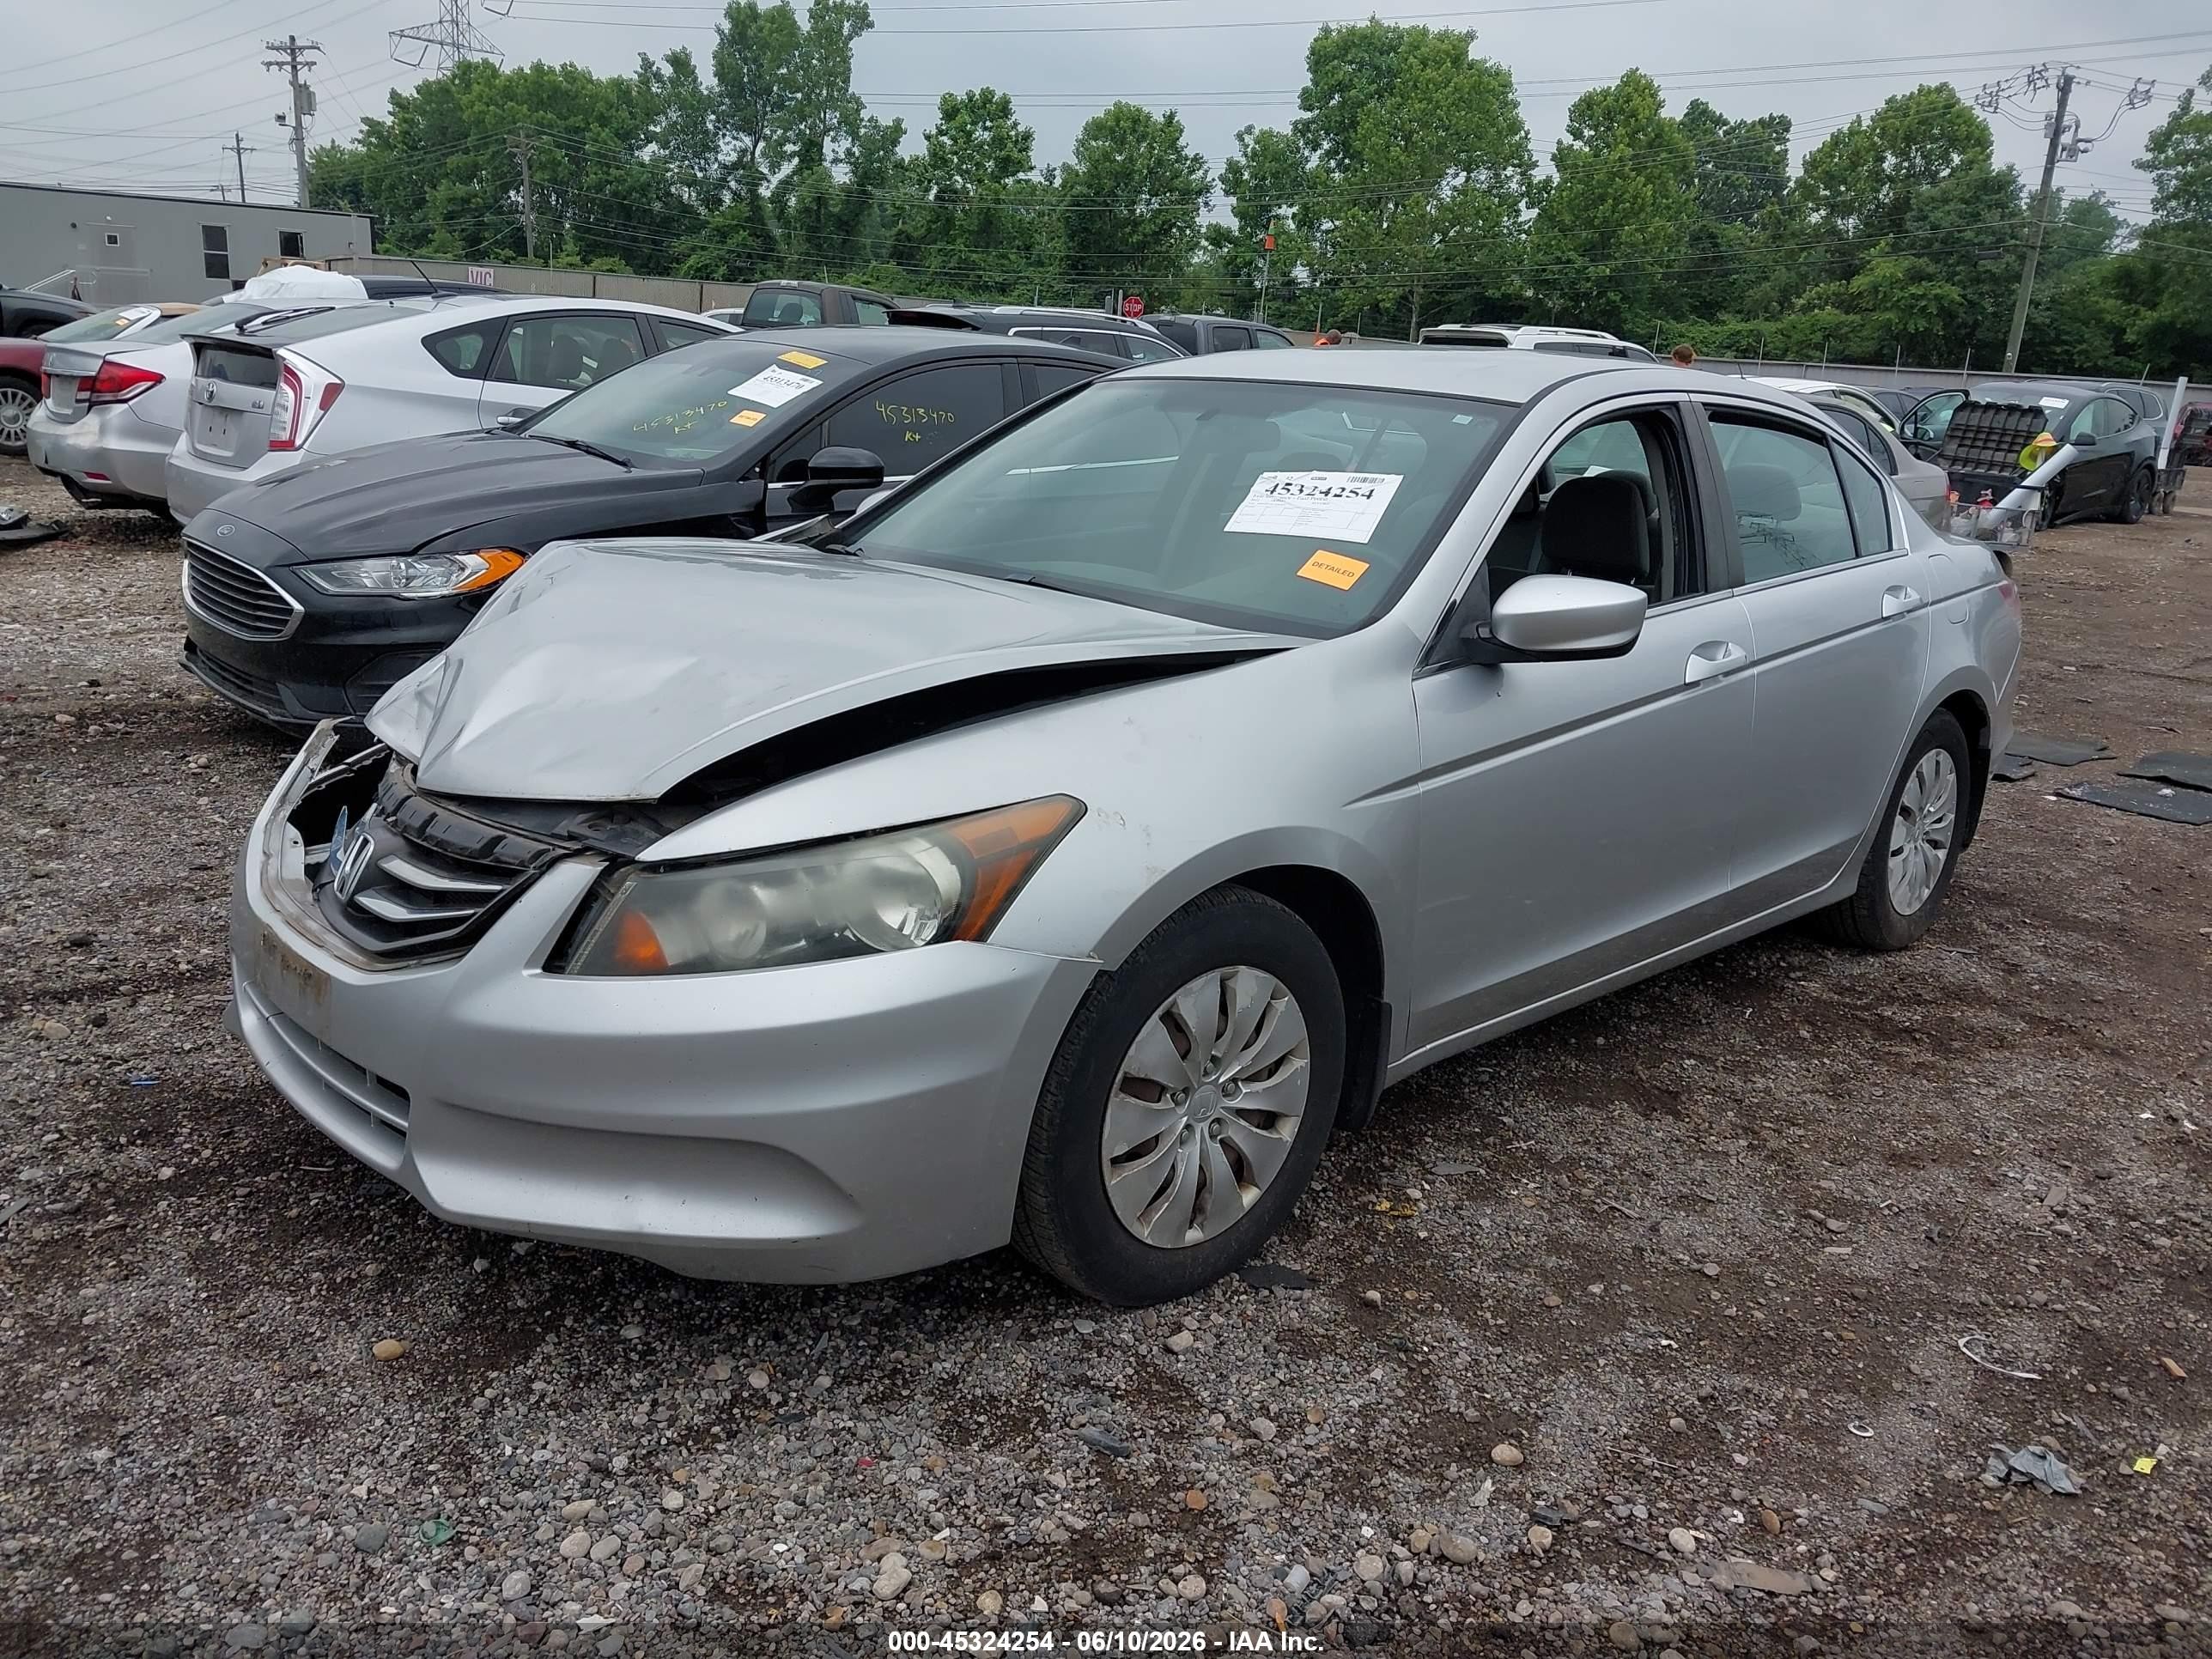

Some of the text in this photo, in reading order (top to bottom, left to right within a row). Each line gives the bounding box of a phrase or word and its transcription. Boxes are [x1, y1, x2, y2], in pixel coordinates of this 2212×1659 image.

[1125, 303, 1142, 312] STOP
[633, 400, 727, 432] 45313470
[876, 399, 955, 426] 45313470
[1265, 483, 1376, 501] 45324254
[1311, 561, 1355, 578] DETAILED
